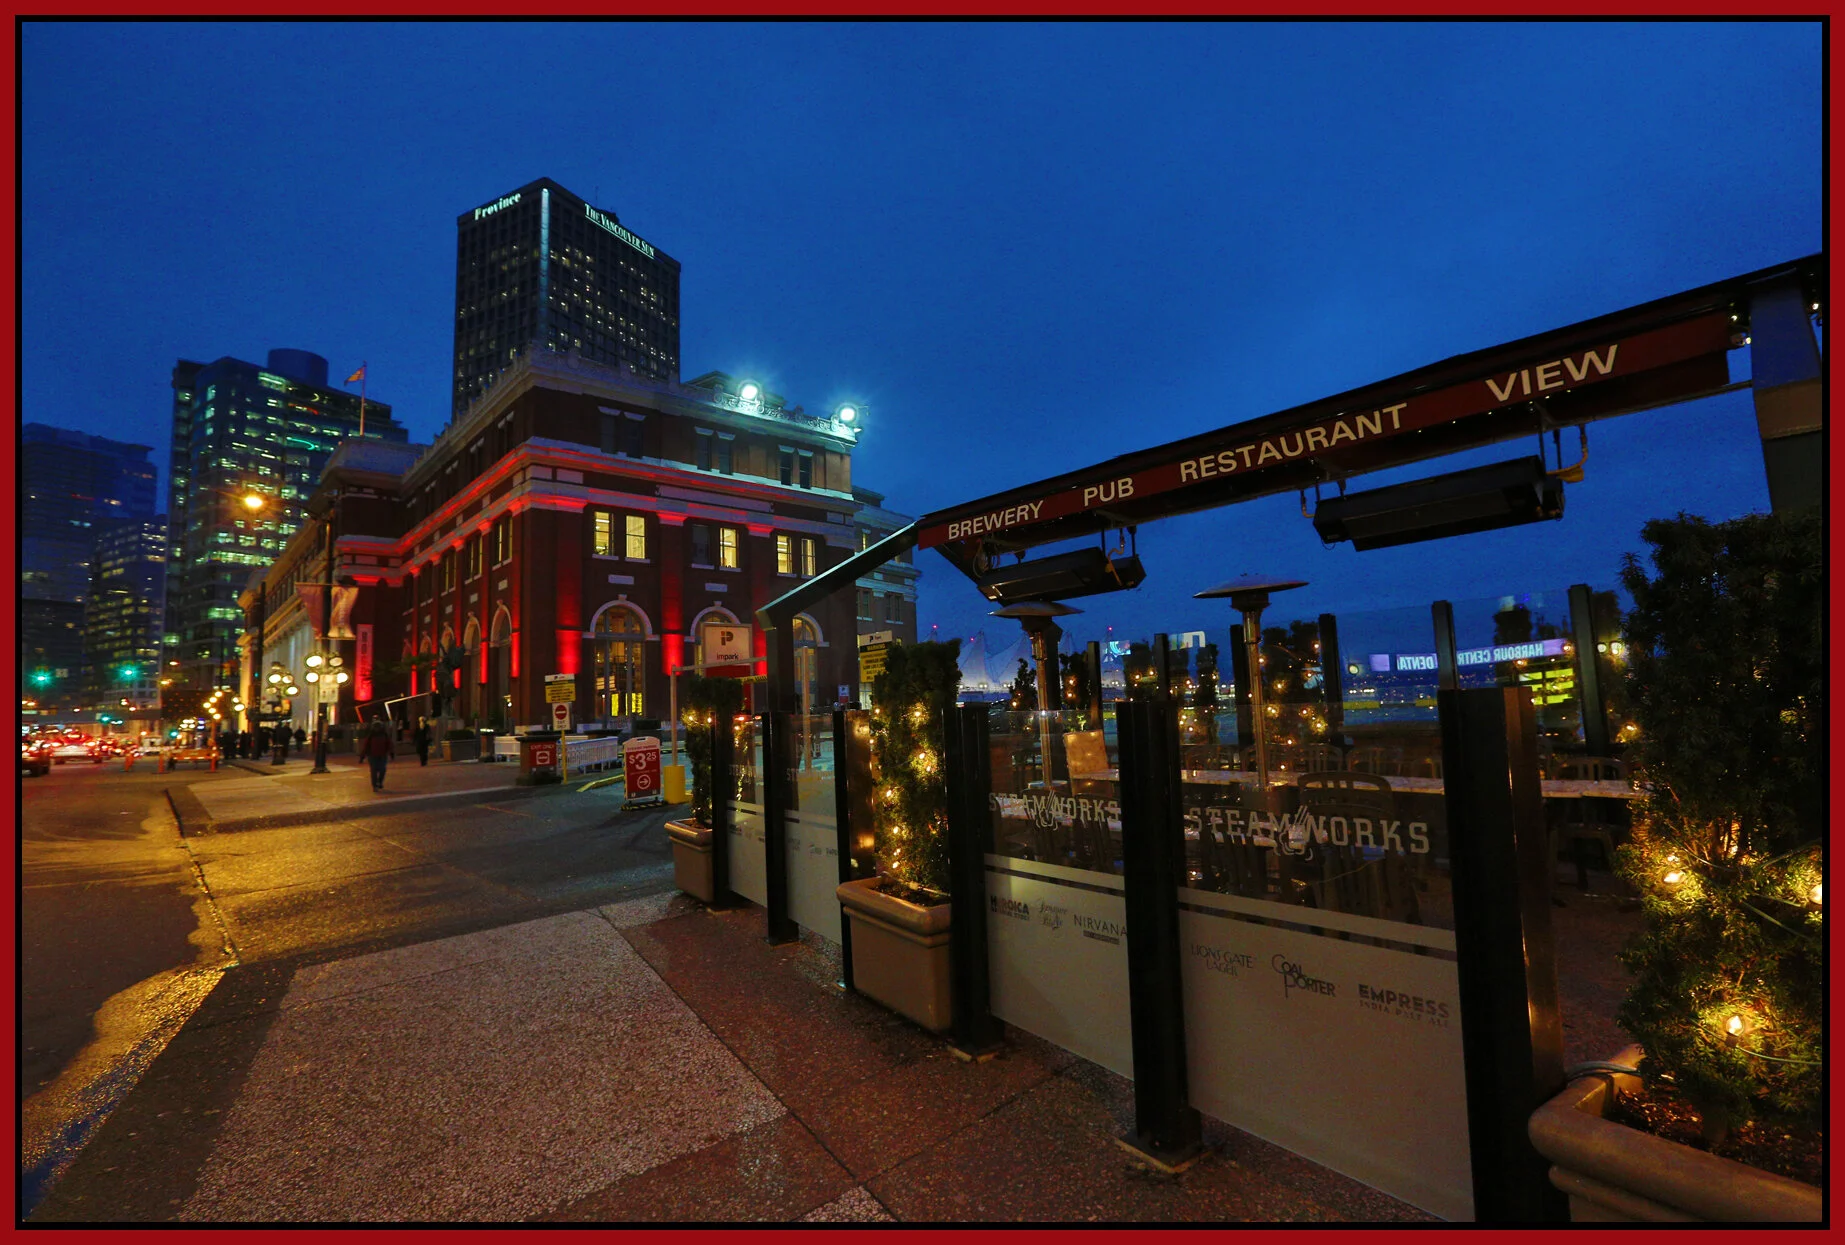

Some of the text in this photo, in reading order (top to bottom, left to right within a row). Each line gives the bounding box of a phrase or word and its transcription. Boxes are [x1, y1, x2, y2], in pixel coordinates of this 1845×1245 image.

[474, 192, 522, 221] Province
[584, 203, 655, 257] THE VANCOUVER SUN
[948, 344, 1618, 540] BREWERY PUB RESTAURANT VIEW
[717, 652, 739, 661] impark
[1188, 807, 1430, 855] STEAMWORKS
[1074, 914, 1127, 936] NIRVANA
[1223, 951, 1254, 969] GATE
[1284, 970, 1336, 998] PORTER
[1358, 983, 1450, 1018] EMPRESS
